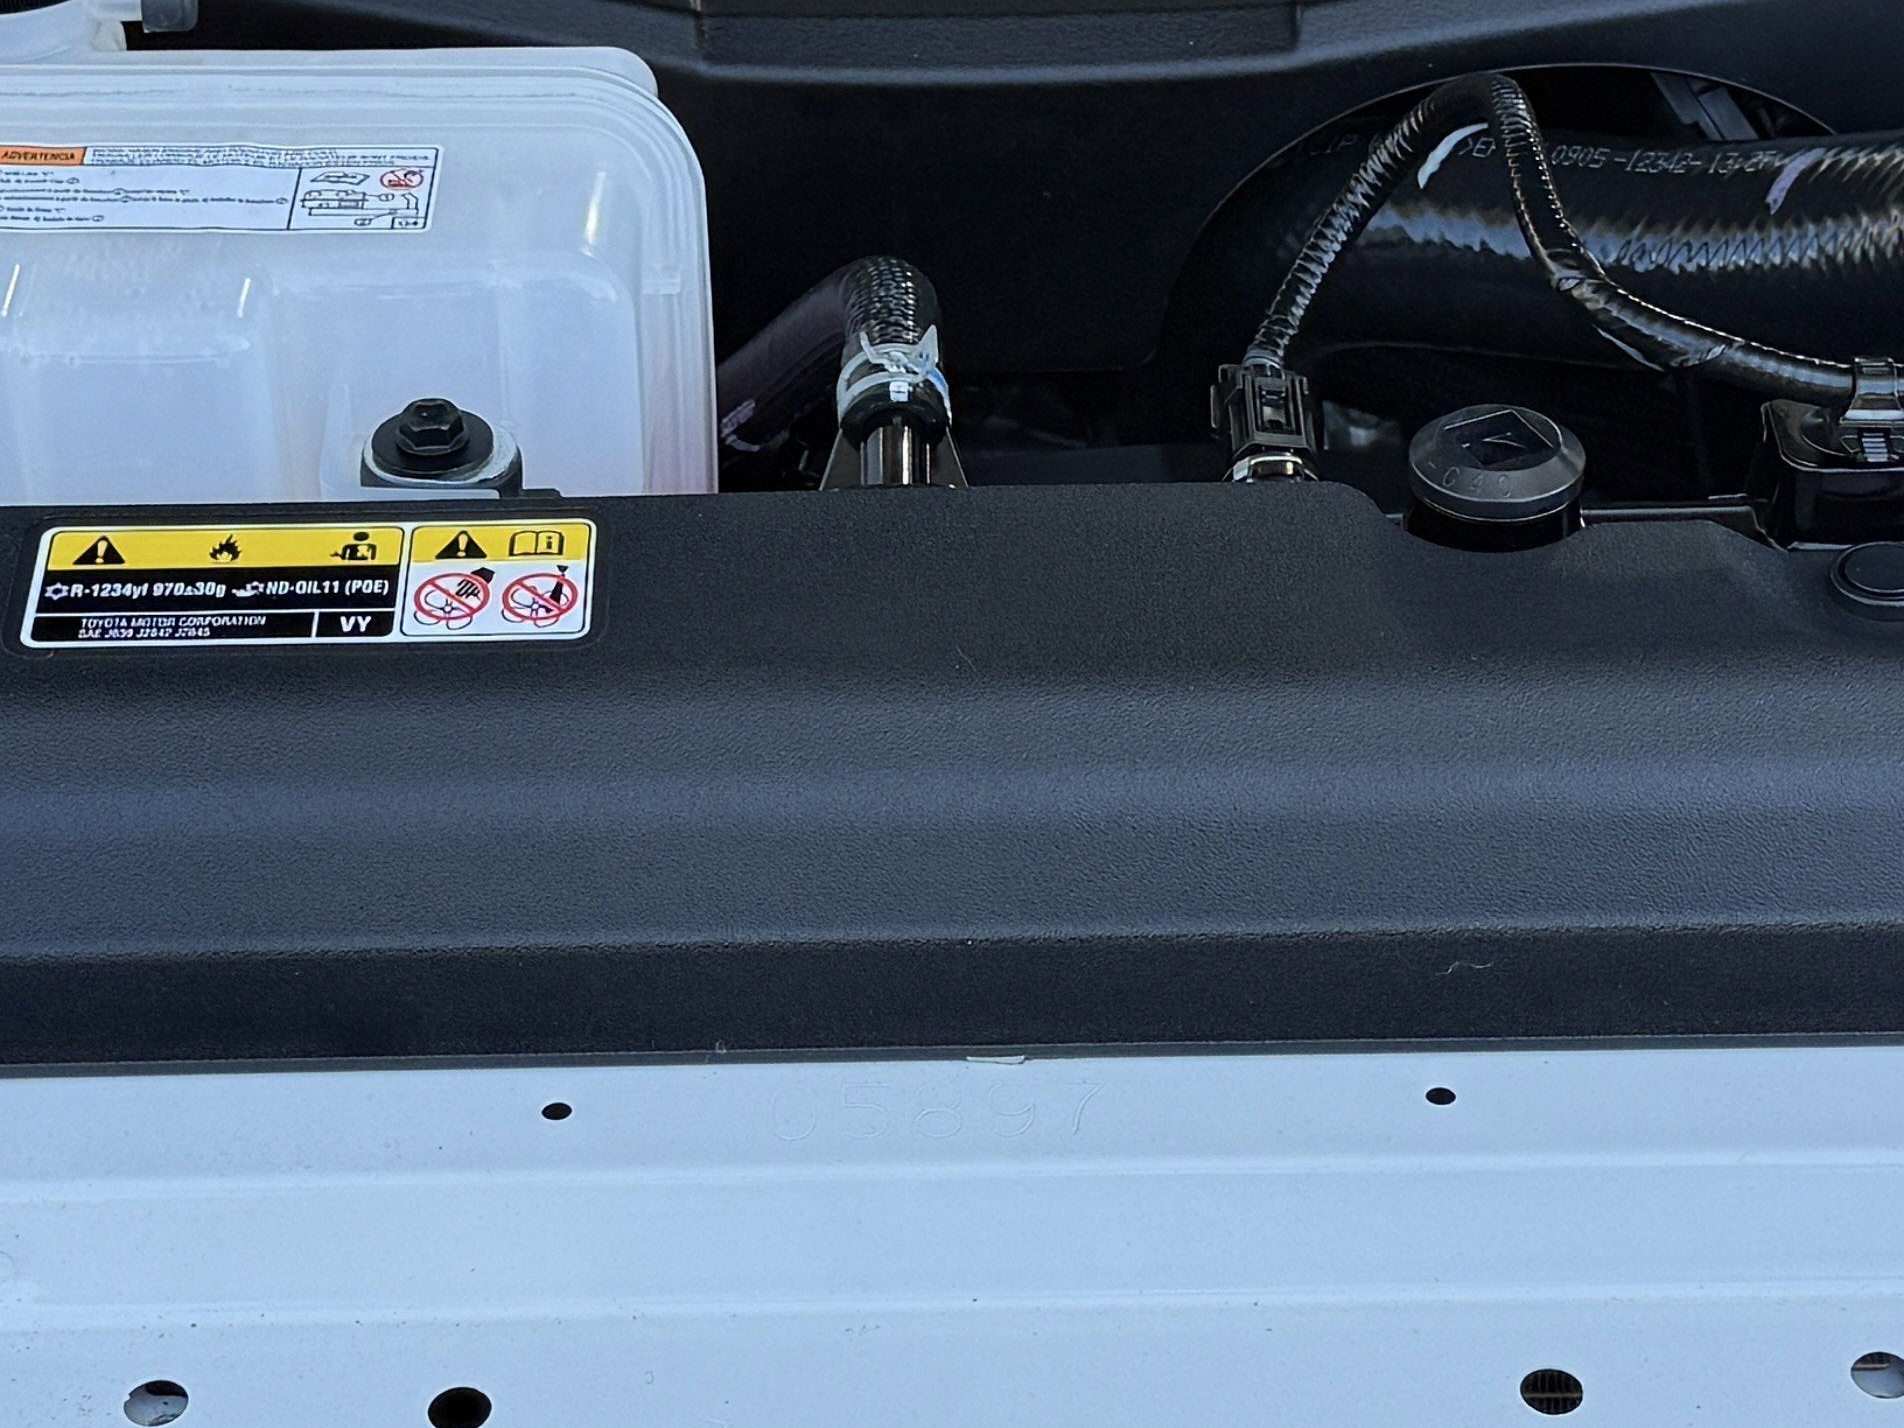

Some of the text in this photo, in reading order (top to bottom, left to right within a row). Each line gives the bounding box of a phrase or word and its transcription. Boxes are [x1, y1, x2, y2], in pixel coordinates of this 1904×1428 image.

[0, 150, 77, 162] ADVERTENCIA
[70, 582, 149, 600] R-1234yf
[343, 580, 390, 596] (POE)
[80, 615, 267, 629] TOYOTA MOTOR CORPORATION
[339, 615, 372, 632] VY
[770, 1079, 1107, 1141] 05897
